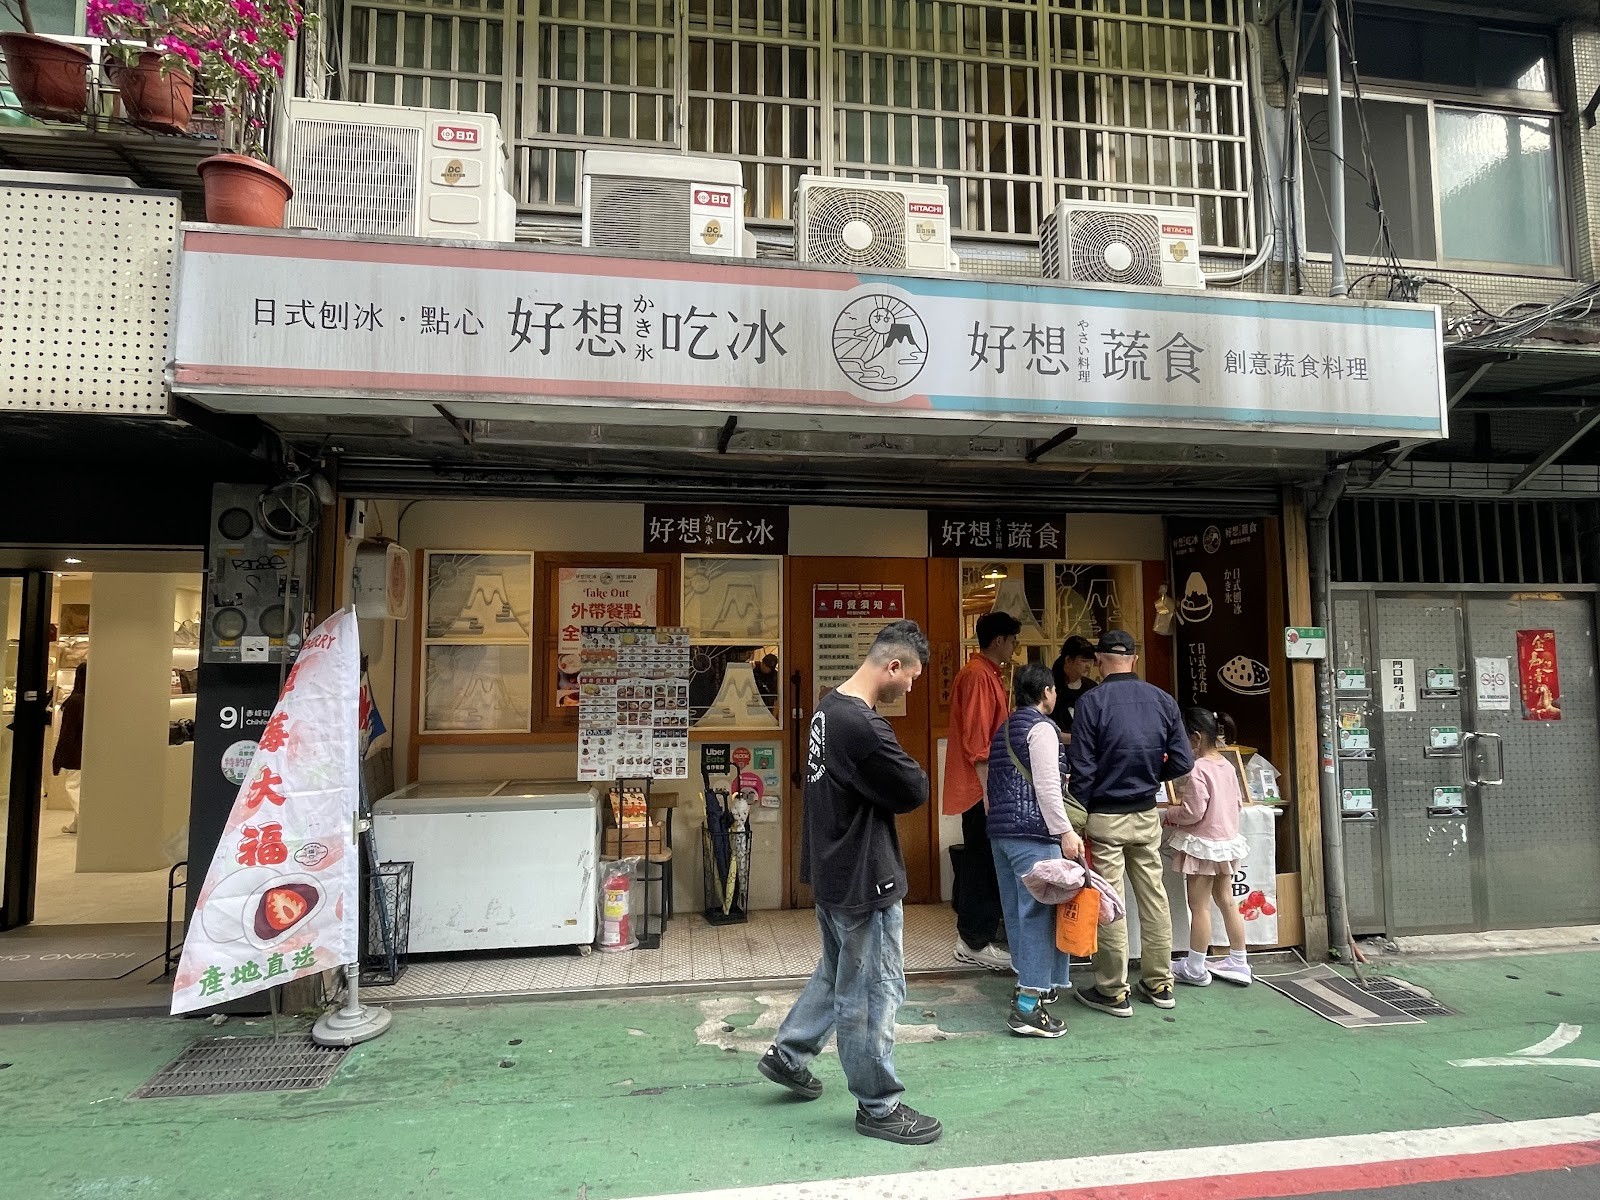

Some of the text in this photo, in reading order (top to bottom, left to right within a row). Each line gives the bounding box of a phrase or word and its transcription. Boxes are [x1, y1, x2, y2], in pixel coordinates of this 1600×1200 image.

[456, 131, 475, 142] 日立
[447, 166, 461, 174] DC
[711, 193, 730, 204] 日立
[910, 205, 942, 213] HITACHI
[706, 226, 719, 234] DC
[1163, 226, 1192, 235] HITACHI
[632, 294, 655, 362] かき氷
[1077, 319, 1091, 384] やさい料理
[1222, 348, 1370, 381] 創意蔬食料理
[583, 587, 629, 600] Take Out
[571, 602, 641, 620] 外帶餐點
[1305, 642, 1312, 655] 7
[1197, 643, 1208, 693] 日式定食
[1349, 679, 1354, 688] 7
[220, 706, 238, 729] 9
[1353, 738, 1358, 747] 7
[705, 748, 726, 756] Uber
